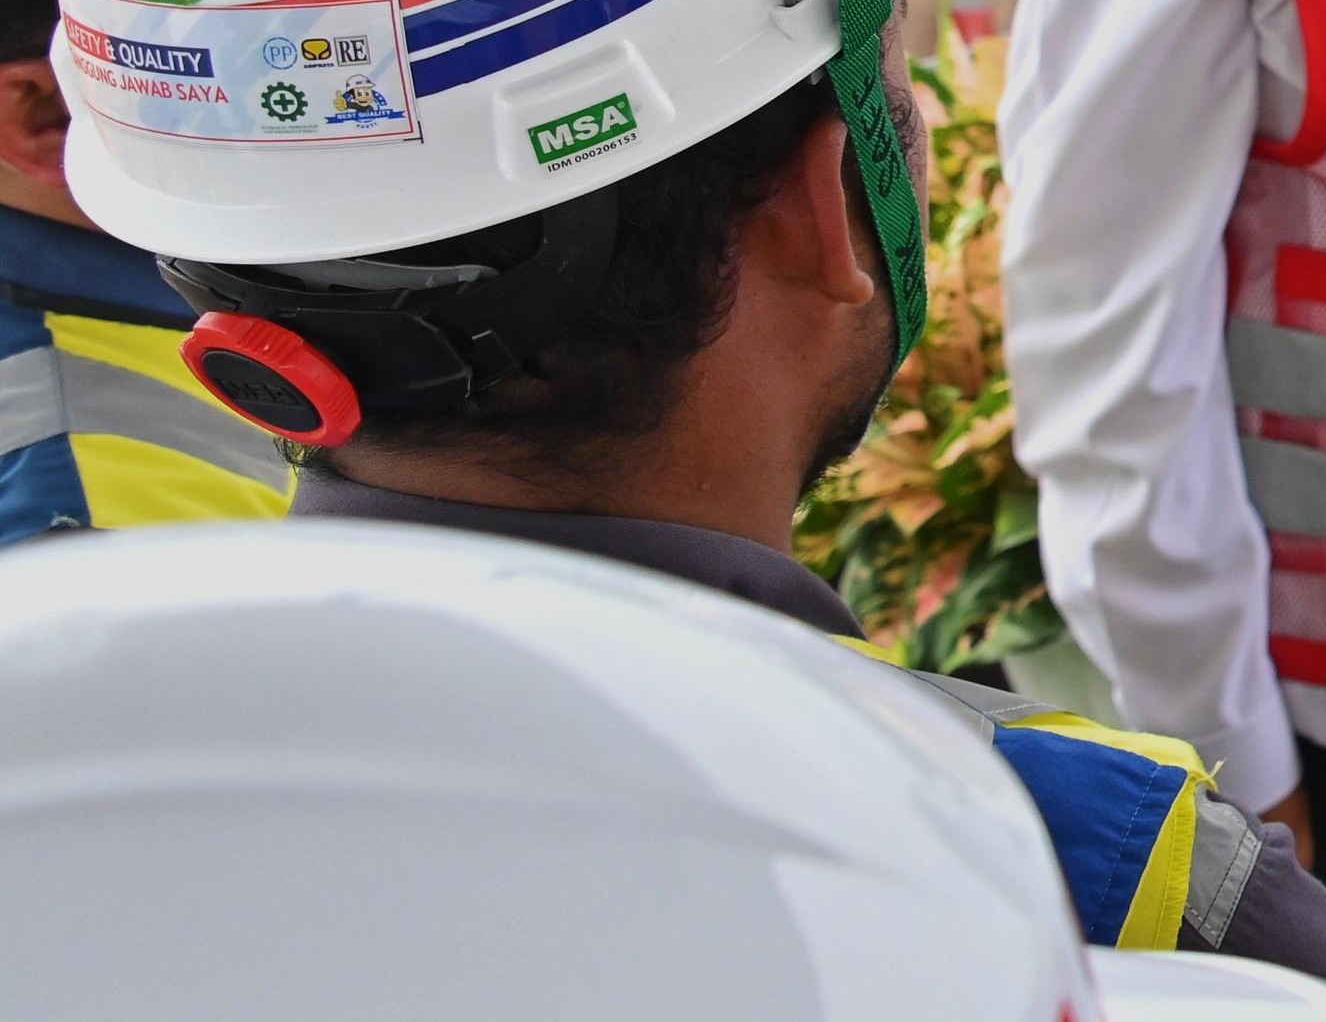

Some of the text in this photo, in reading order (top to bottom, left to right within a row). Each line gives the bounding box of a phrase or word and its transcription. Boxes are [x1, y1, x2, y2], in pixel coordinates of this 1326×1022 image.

[104, 38, 117, 61] &
[119, 42, 202, 73] QUALITY
[269, 45, 293, 63] PP
[338, 39, 368, 63] RE
[121, 74, 172, 99] JAWAB
[176, 83, 230, 104] SAYA
[336, 110, 391, 120] BEST QUALITY
[537, 105, 628, 154] MSA
[547, 132, 637, 173] IDM 000206153
